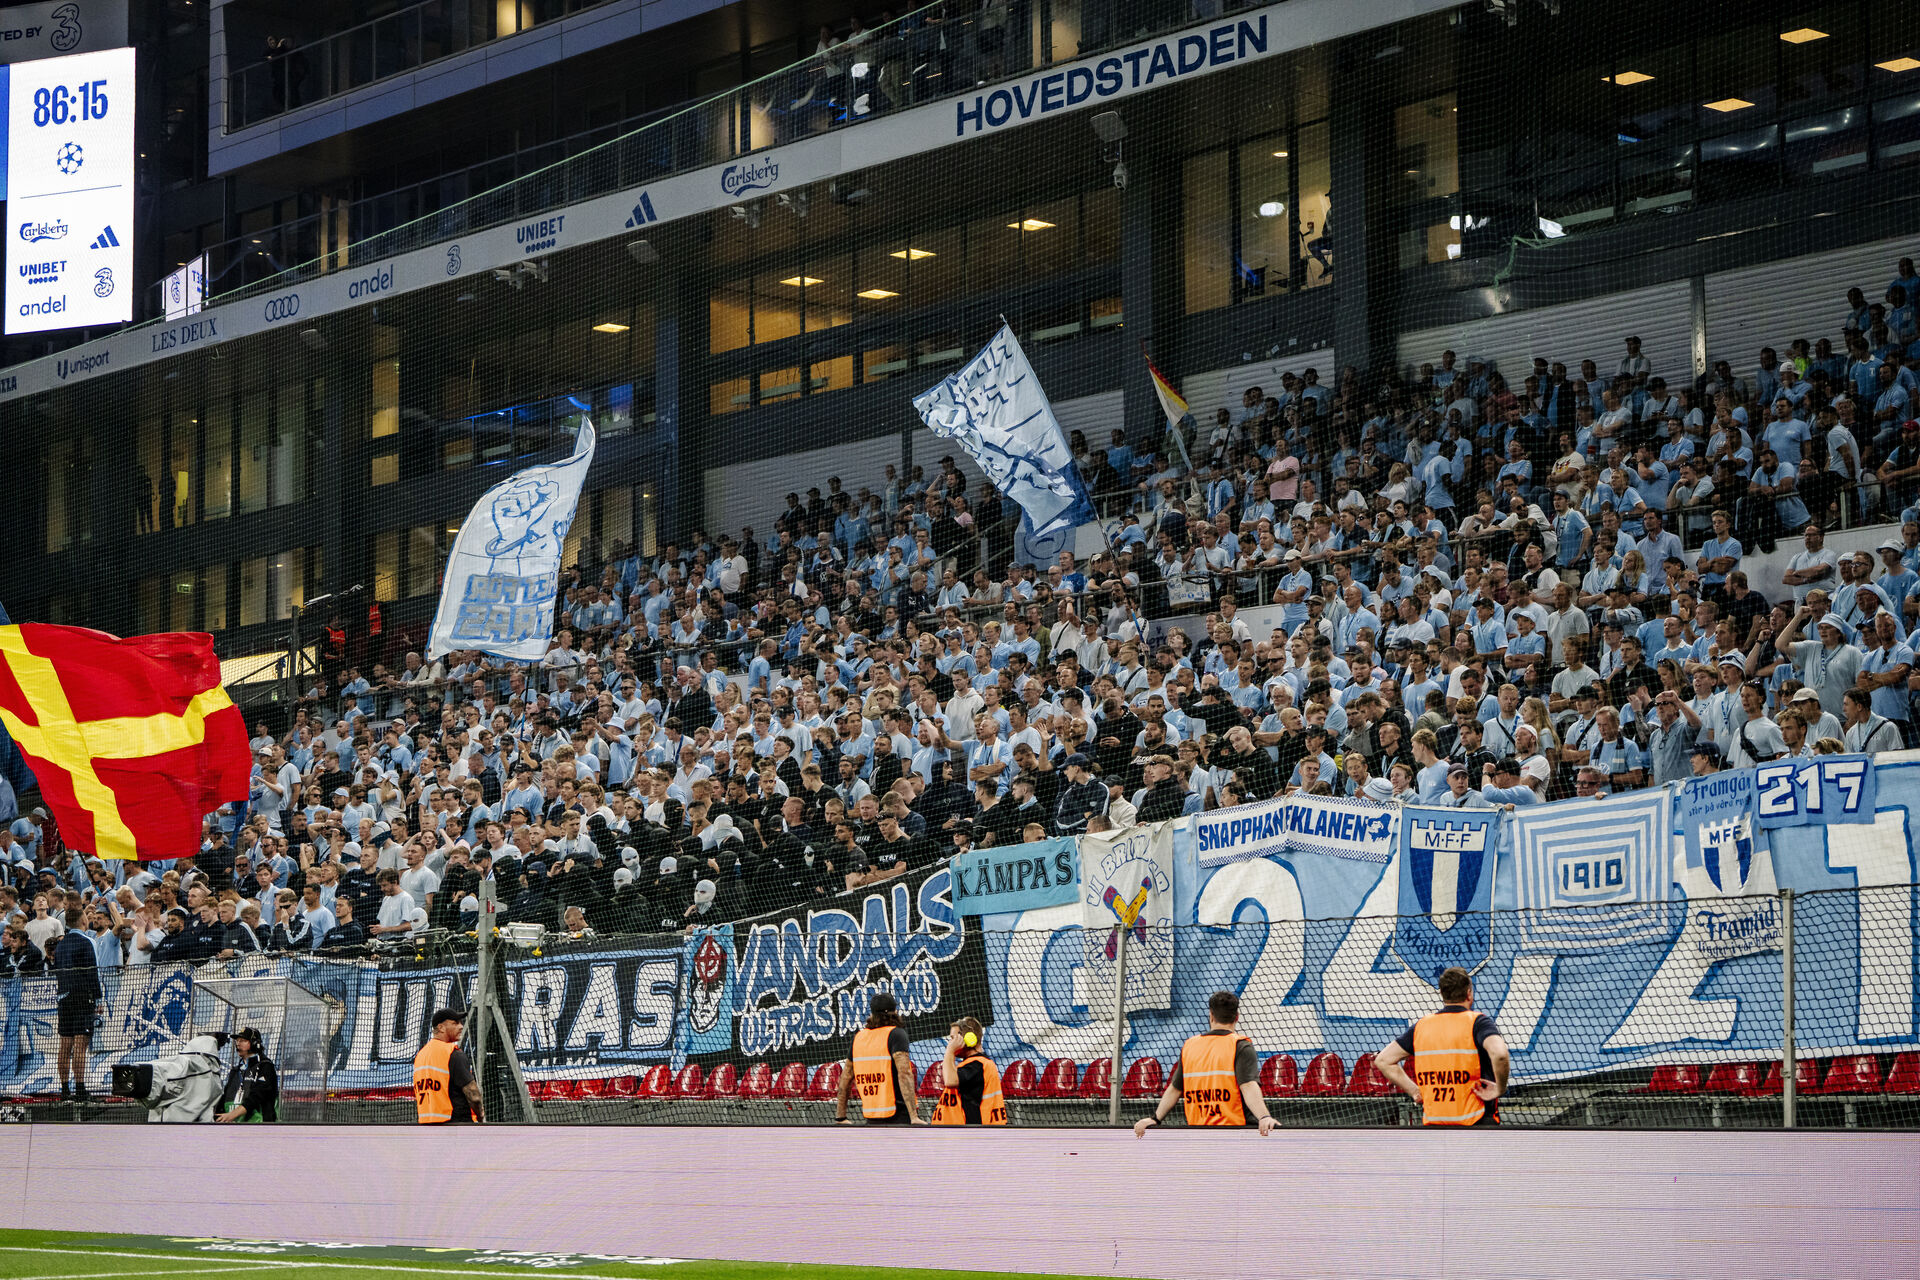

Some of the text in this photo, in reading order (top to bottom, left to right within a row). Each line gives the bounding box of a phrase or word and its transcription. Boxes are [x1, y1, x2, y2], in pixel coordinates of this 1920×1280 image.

[26, 26, 43, 38] BY
[956, 14, 1268, 137] HOVEDSTADEN
[33, 79, 108, 127] 86:15
[721, 157, 779, 197] Carlsberg
[20, 219, 69, 244] Carlsberg
[516, 215, 565, 245] UNIBET
[20, 261, 67, 277] UNIBET
[349, 264, 394, 299] andel
[20, 295, 66, 317] andel
[152, 317, 218, 354] LES DEUX
[69, 351, 110, 373] unisport
[1756, 759, 1868, 818] 217
[1198, 804, 1370, 852] SNAPPHANEKLANEN
[1709, 824, 1742, 845] MFF
[1562, 857, 1625, 890] 1910
[1696, 899, 1775, 941] Framtid
[732, 867, 965, 1016] VANDALS
[1402, 925, 1486, 958] Malmö FF
[740, 993, 837, 1056] ULTRAS
[863, 1085, 879, 1097] 687
[1418, 1070, 1471, 1087] STEWARD
[1433, 1087, 1456, 1102] 272
